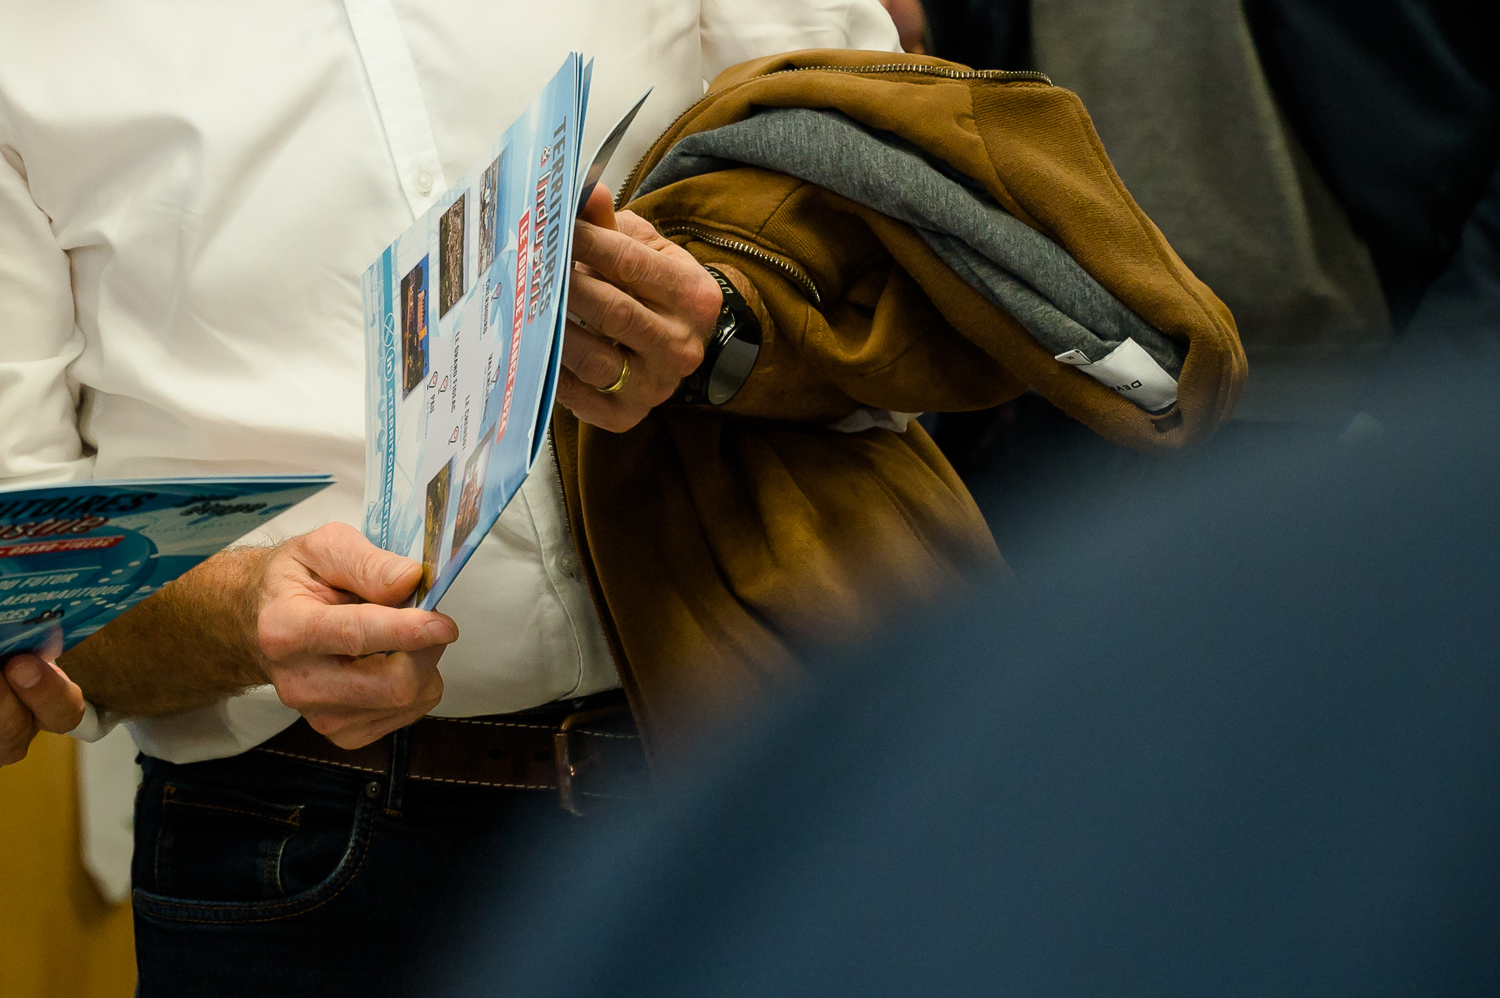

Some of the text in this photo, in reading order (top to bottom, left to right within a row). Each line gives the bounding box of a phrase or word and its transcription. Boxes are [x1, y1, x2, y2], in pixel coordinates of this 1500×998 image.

[519, 219, 529, 244] LE
[526, 145, 552, 325] & Industrie
[539, 115, 567, 318] TERRITOIRES
[516, 248, 528, 290] TOUR
[514, 295, 524, 318] DE
[506, 322, 521, 385] FRANCE
[20, 573, 78, 589] FUTUR
